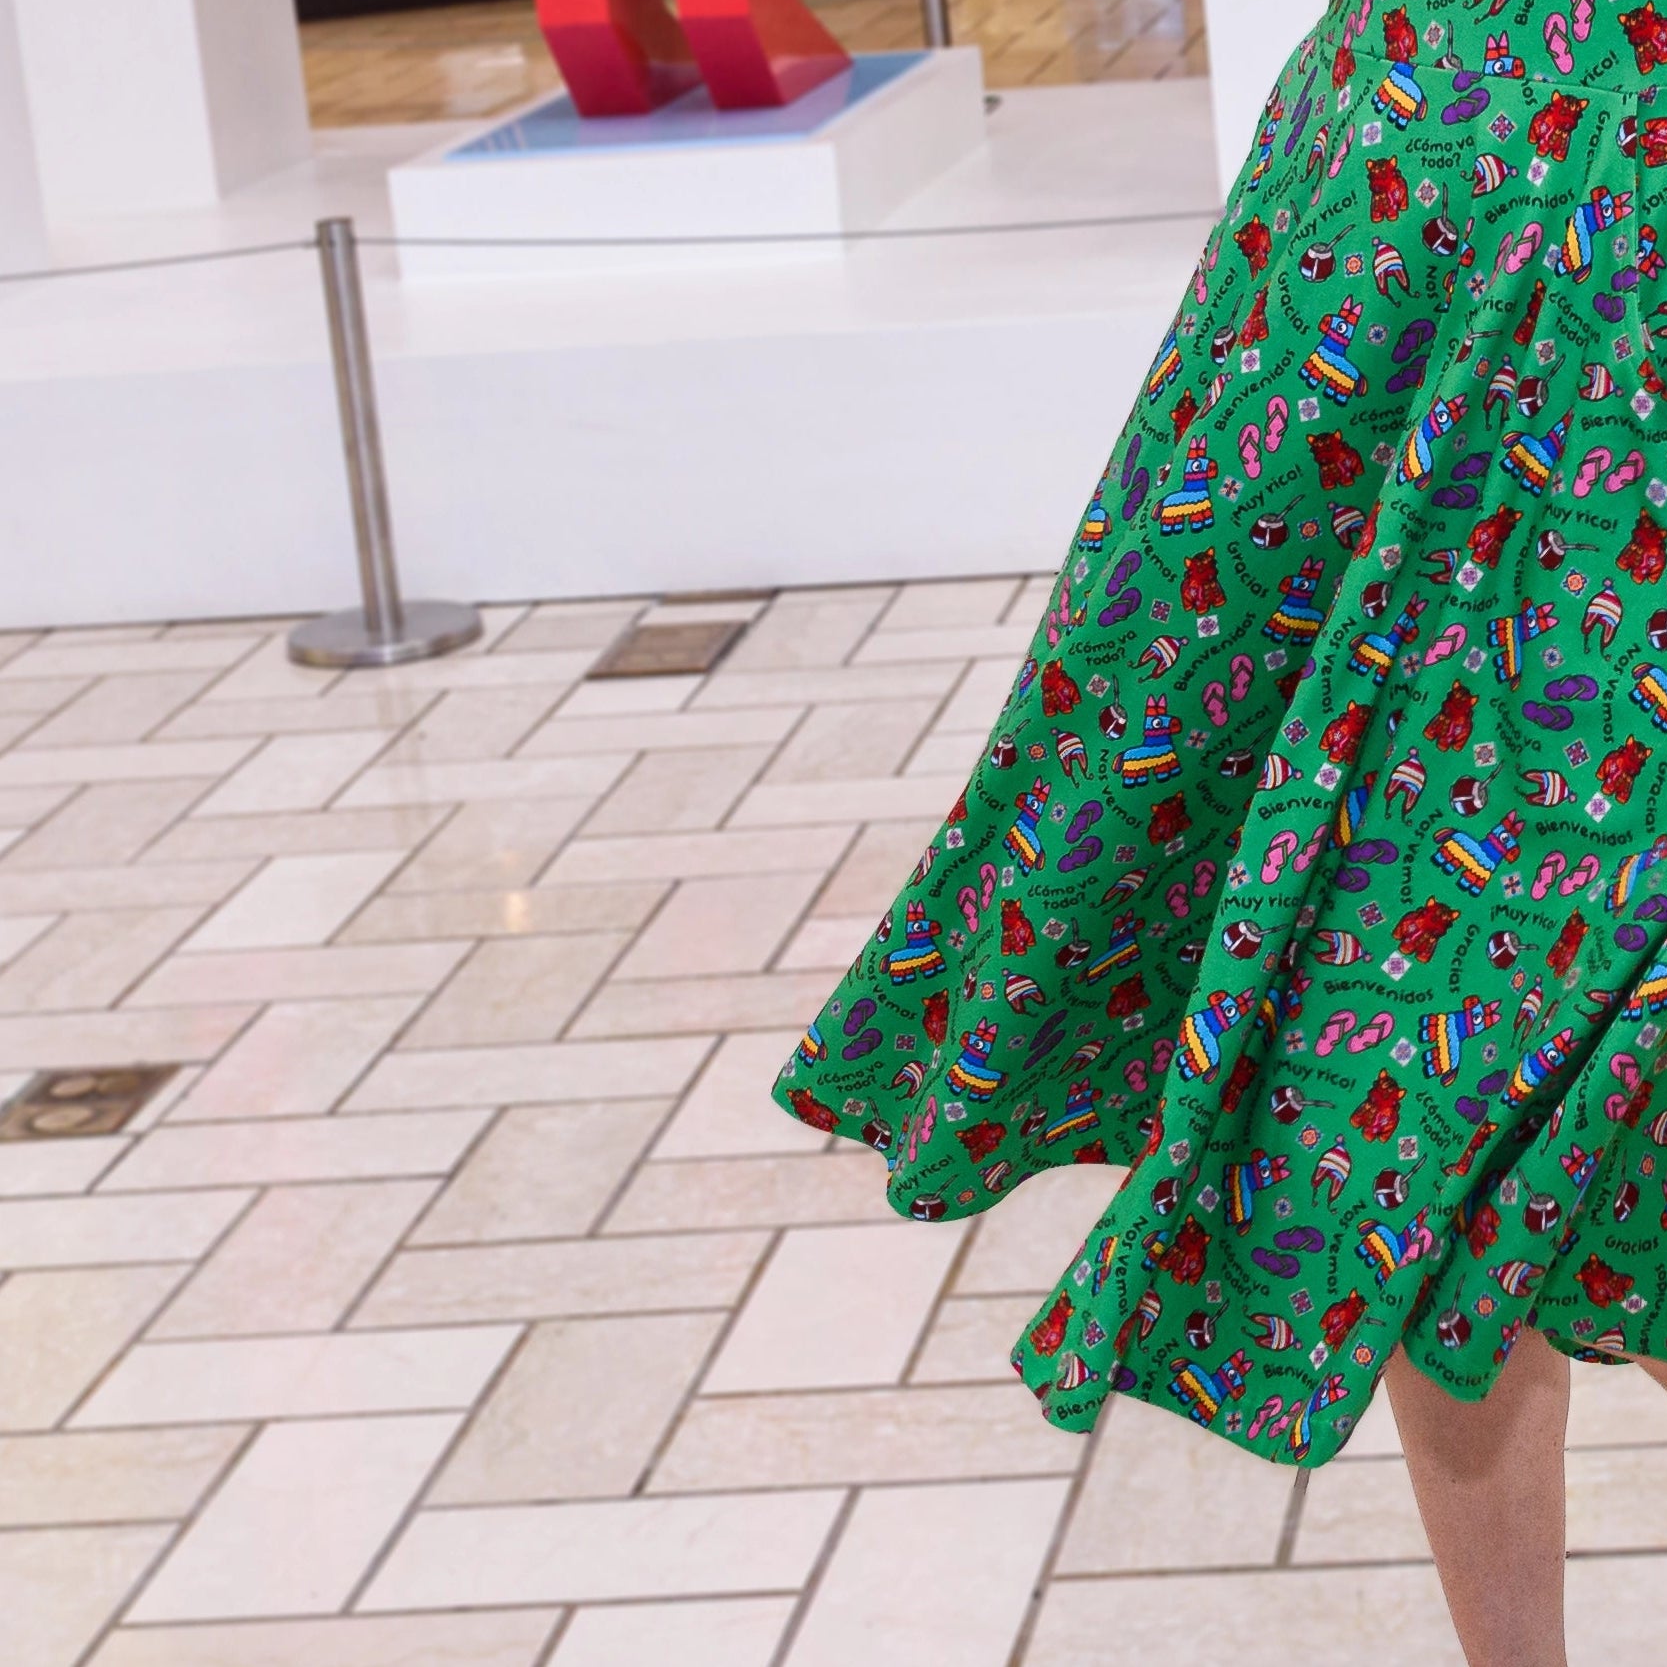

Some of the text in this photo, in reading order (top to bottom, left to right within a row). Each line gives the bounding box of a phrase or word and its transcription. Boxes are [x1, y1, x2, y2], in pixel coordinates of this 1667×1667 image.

[1580, 51, 1618, 87] rico!
[1405, 135, 1475, 154] ¿Cómo va
[1420, 153, 1461, 169] todo?
[1287, 190, 1358, 255] ¡Muy rico!
[1277, 271, 1310, 335] Gracias
[1426, 265, 1439, 299] Nos
[1193, 311, 1216, 356] ¡Muy
[1211, 267, 1239, 308] rico!
[1214, 349, 1295, 431] Bienvenidos
[1230, 464, 1303, 527] ¡Muy rico!
[1577, 510, 1618, 534] rico!
[1141, 535, 1178, 583] vemos
[1227, 541, 1269, 599] Gracias
[1068, 631, 1137, 656] ¿Cómo va
[1085, 647, 1126, 666] todo?
[1174, 612, 1257, 692] Bienvenidos
[1321, 617, 1357, 714] Nos vemos
[1603, 643, 1642, 744] Nos vemos
[1099, 749, 1143, 829] Nos vemos
[1401, 808, 1444, 905] Nos vemos
[1535, 819, 1634, 846] Bienvenidos
[929, 824, 997, 898] Bienvenidos
[1027, 875, 1099, 899] ¿Cómo va
[1043, 891, 1087, 910] todo?
[1490, 904, 1529, 927] ¡Muy
[1450, 924, 1480, 994] Gracias
[867, 951, 917, 1019] Nos vemos
[1323, 980, 1434, 1005] Bienvenidos
[1273, 1058, 1356, 1090] ¡Muy rico!
[919, 1154, 956, 1178] rico!
[1116, 1215, 1148, 1317] Nos vemos
[1327, 1199, 1367, 1295] Nos vemos
[1605, 1235, 1660, 1255] Gracias
[1152, 1337, 1181, 1367] Nos
